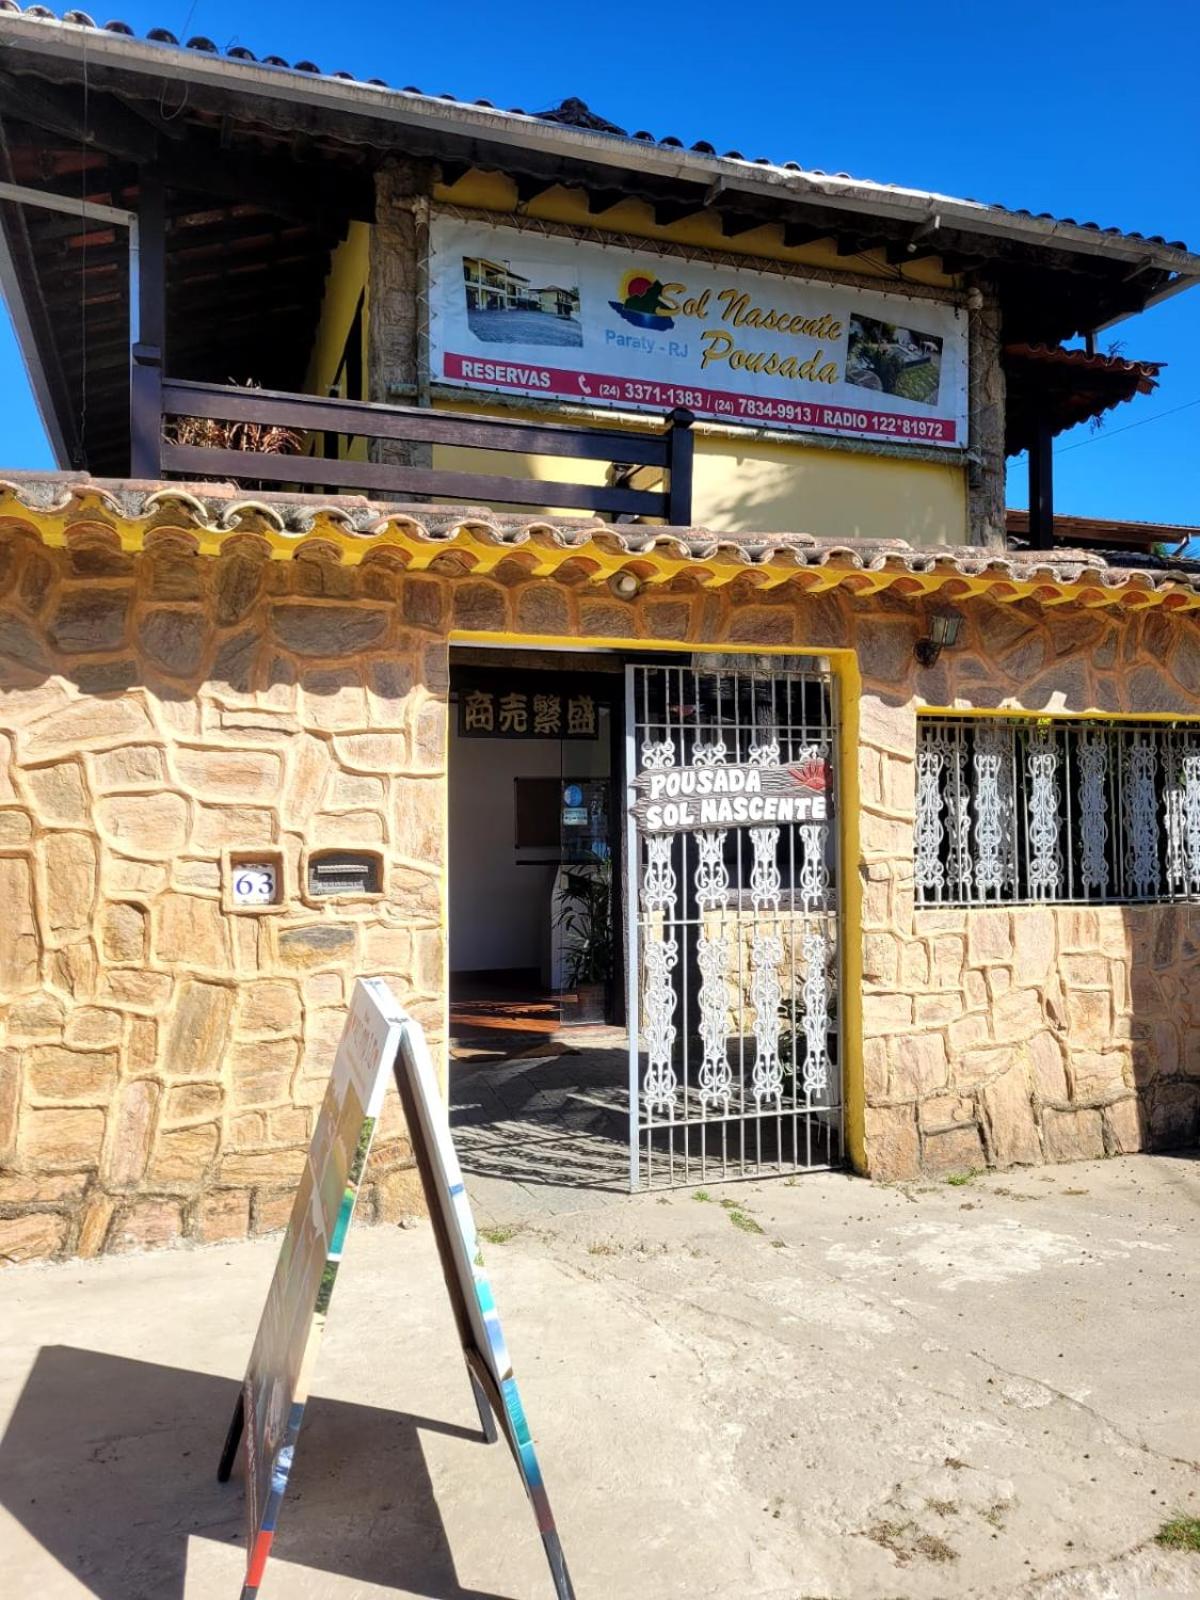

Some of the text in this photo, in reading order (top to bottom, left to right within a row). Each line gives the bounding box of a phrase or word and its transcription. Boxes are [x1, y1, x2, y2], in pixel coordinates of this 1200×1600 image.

[655, 282, 843, 341] Sol Nascente
[668, 341, 688, 358] RJ
[700, 329, 840, 384] Pousada
[461, 360, 551, 388] RESERVAS
[599, 383, 620, 399] (24)
[624, 382, 703, 407] 3371-1383
[714, 398, 734, 414] (24)
[738, 398, 812, 423] 7834-9913
[823, 410, 867, 429] RADIO
[465, 690, 596, 735] 商売繁盛
[650, 769, 761, 800] POUSADA
[646, 796, 826, 830] SOL NASCENTE
[236, 872, 273, 895] 63
